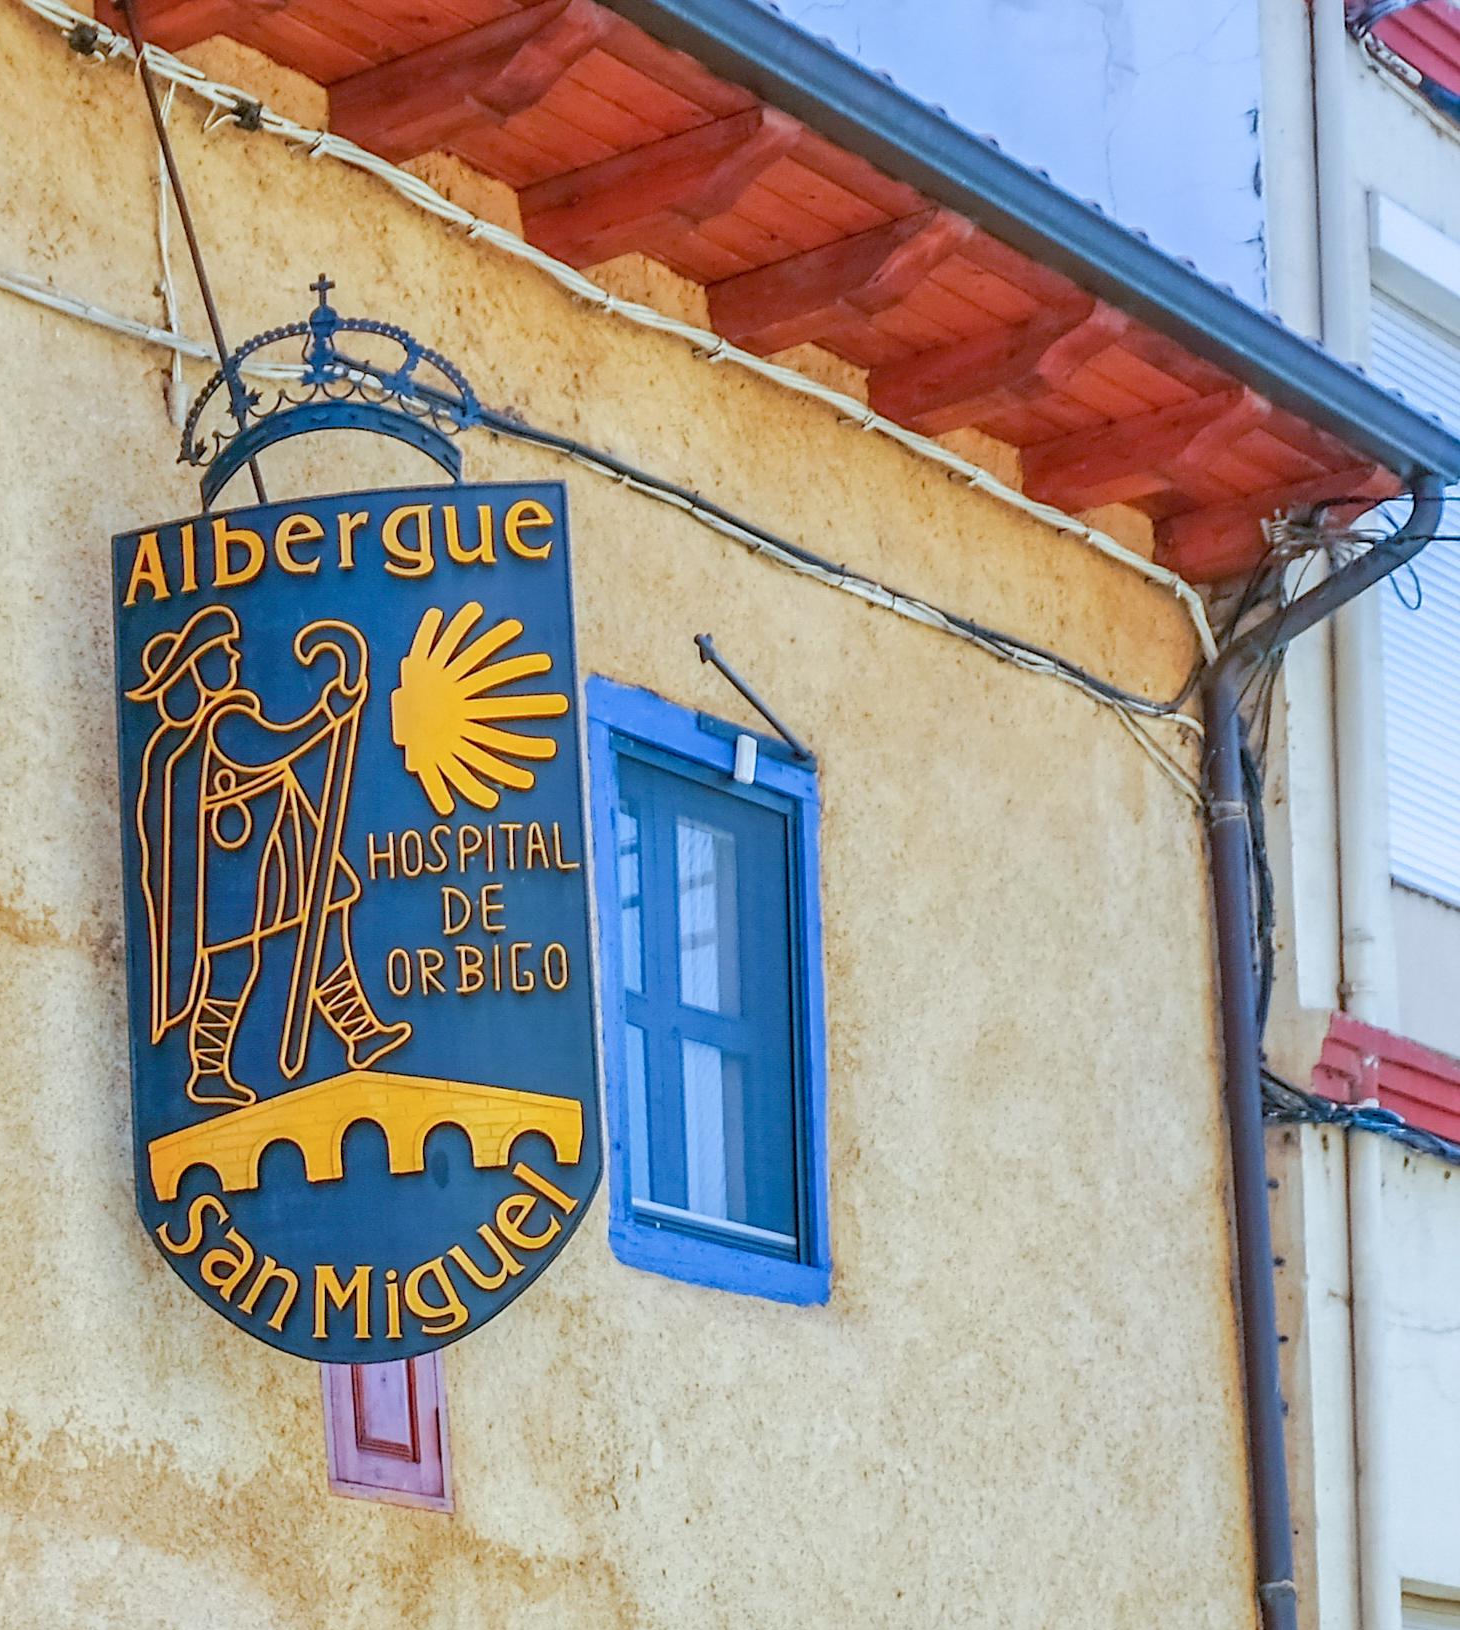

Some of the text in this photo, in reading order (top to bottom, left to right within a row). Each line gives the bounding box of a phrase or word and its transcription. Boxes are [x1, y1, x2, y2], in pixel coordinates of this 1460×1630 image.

[123, 499, 554, 607] Albergue
[367, 821, 580, 879] HOSPITAL
[442, 883, 505, 936] DE
[387, 942, 569, 996] ORBIGO
[156, 1162, 579, 1339] San Miguel
